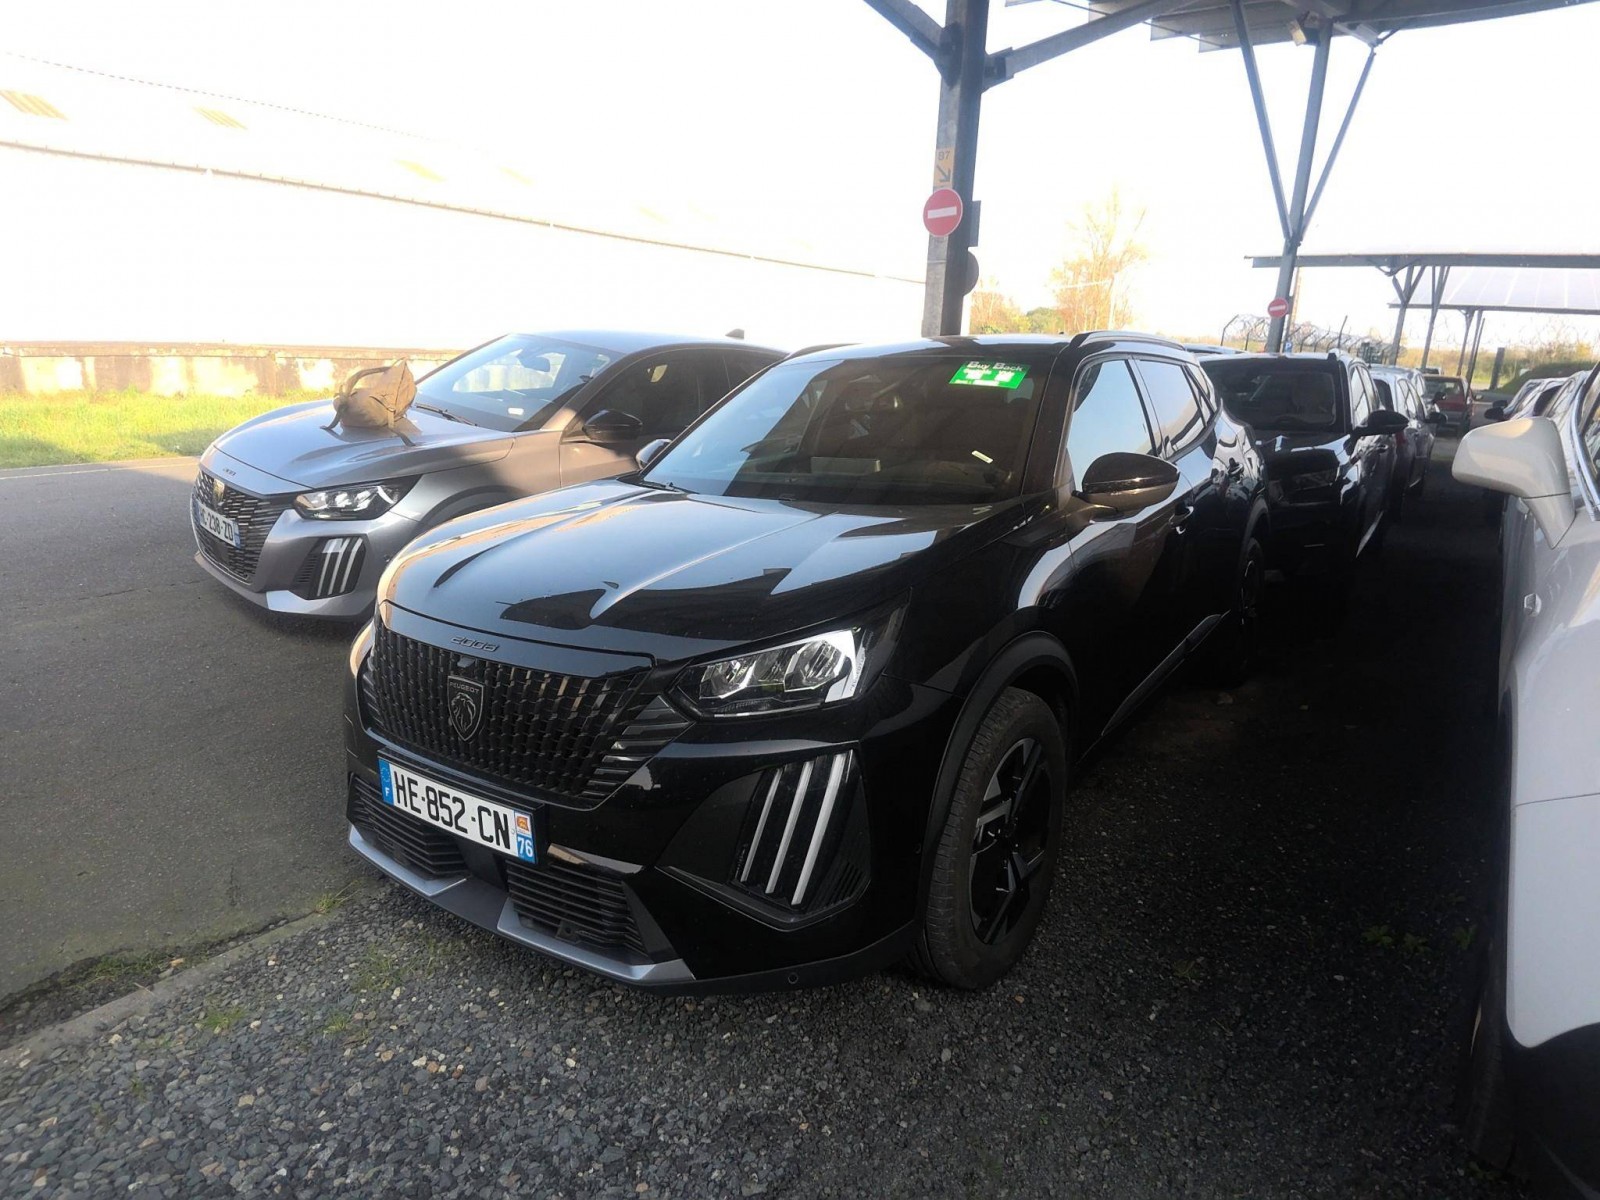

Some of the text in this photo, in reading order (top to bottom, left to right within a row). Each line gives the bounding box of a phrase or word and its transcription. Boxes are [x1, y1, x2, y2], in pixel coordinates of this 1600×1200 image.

[966, 361, 1023, 372] Buy Back
[450, 636, 500, 652] 2008
[449, 681, 480, 693] PEUGEOT
[384, 787, 390, 797] F
[394, 770, 511, 850] HE-852-CN
[517, 836, 534, 858] 76
